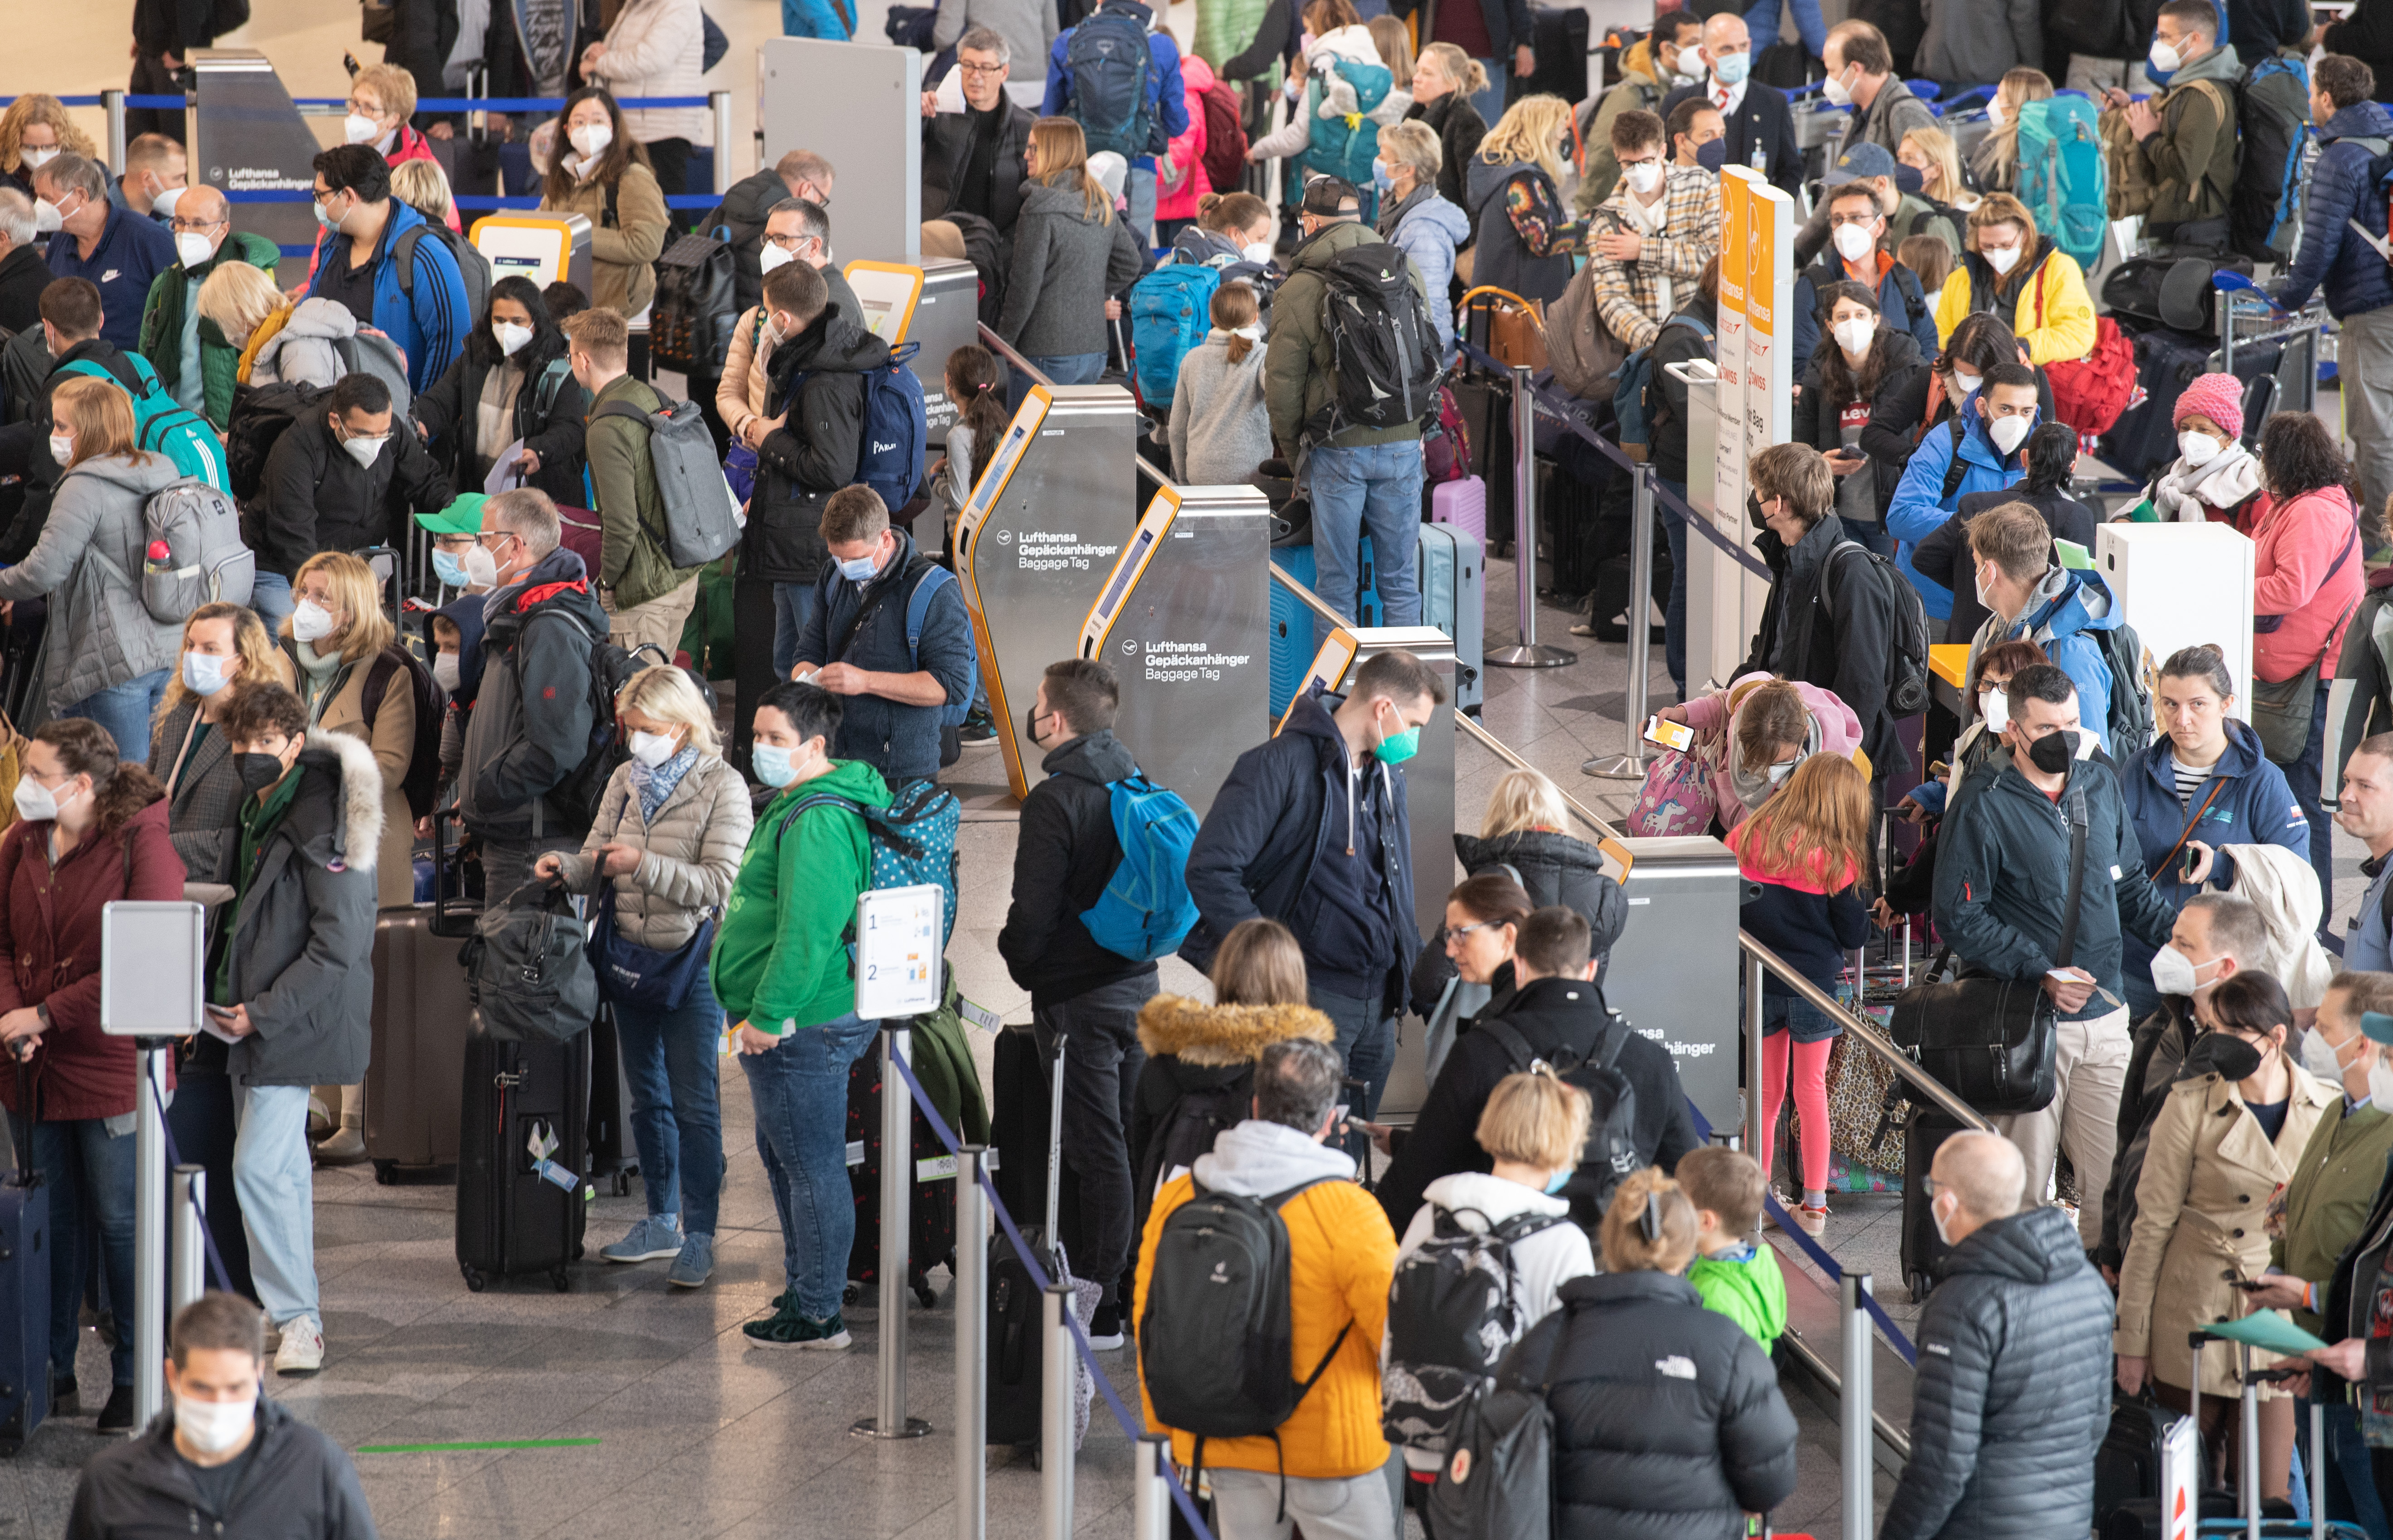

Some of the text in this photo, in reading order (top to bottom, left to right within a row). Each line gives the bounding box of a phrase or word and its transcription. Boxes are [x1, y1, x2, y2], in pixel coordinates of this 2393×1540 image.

[228, 167, 279, 179] Lufthansa
[1723, 366, 1737, 385] SWISS
[1752, 371, 1766, 391] SWISS
[938, 414, 951, 426] Tag
[1842, 407, 1871, 421] Lev
[1753, 409, 1763, 434] Bag
[873, 441, 896, 455] PARLEY
[1019, 532, 1077, 543] Lufthansa
[1019, 544, 1117, 557] Gepäckanhänger
[1019, 557, 1089, 571] Baggage Tag
[1146, 641, 1207, 653] Lufthansa
[1145, 653, 1250, 667] Gepäckanhänger
[1146, 667, 1220, 682] Baggage Tag
[869, 914, 877, 930] 1
[868, 964, 877, 981] 2
